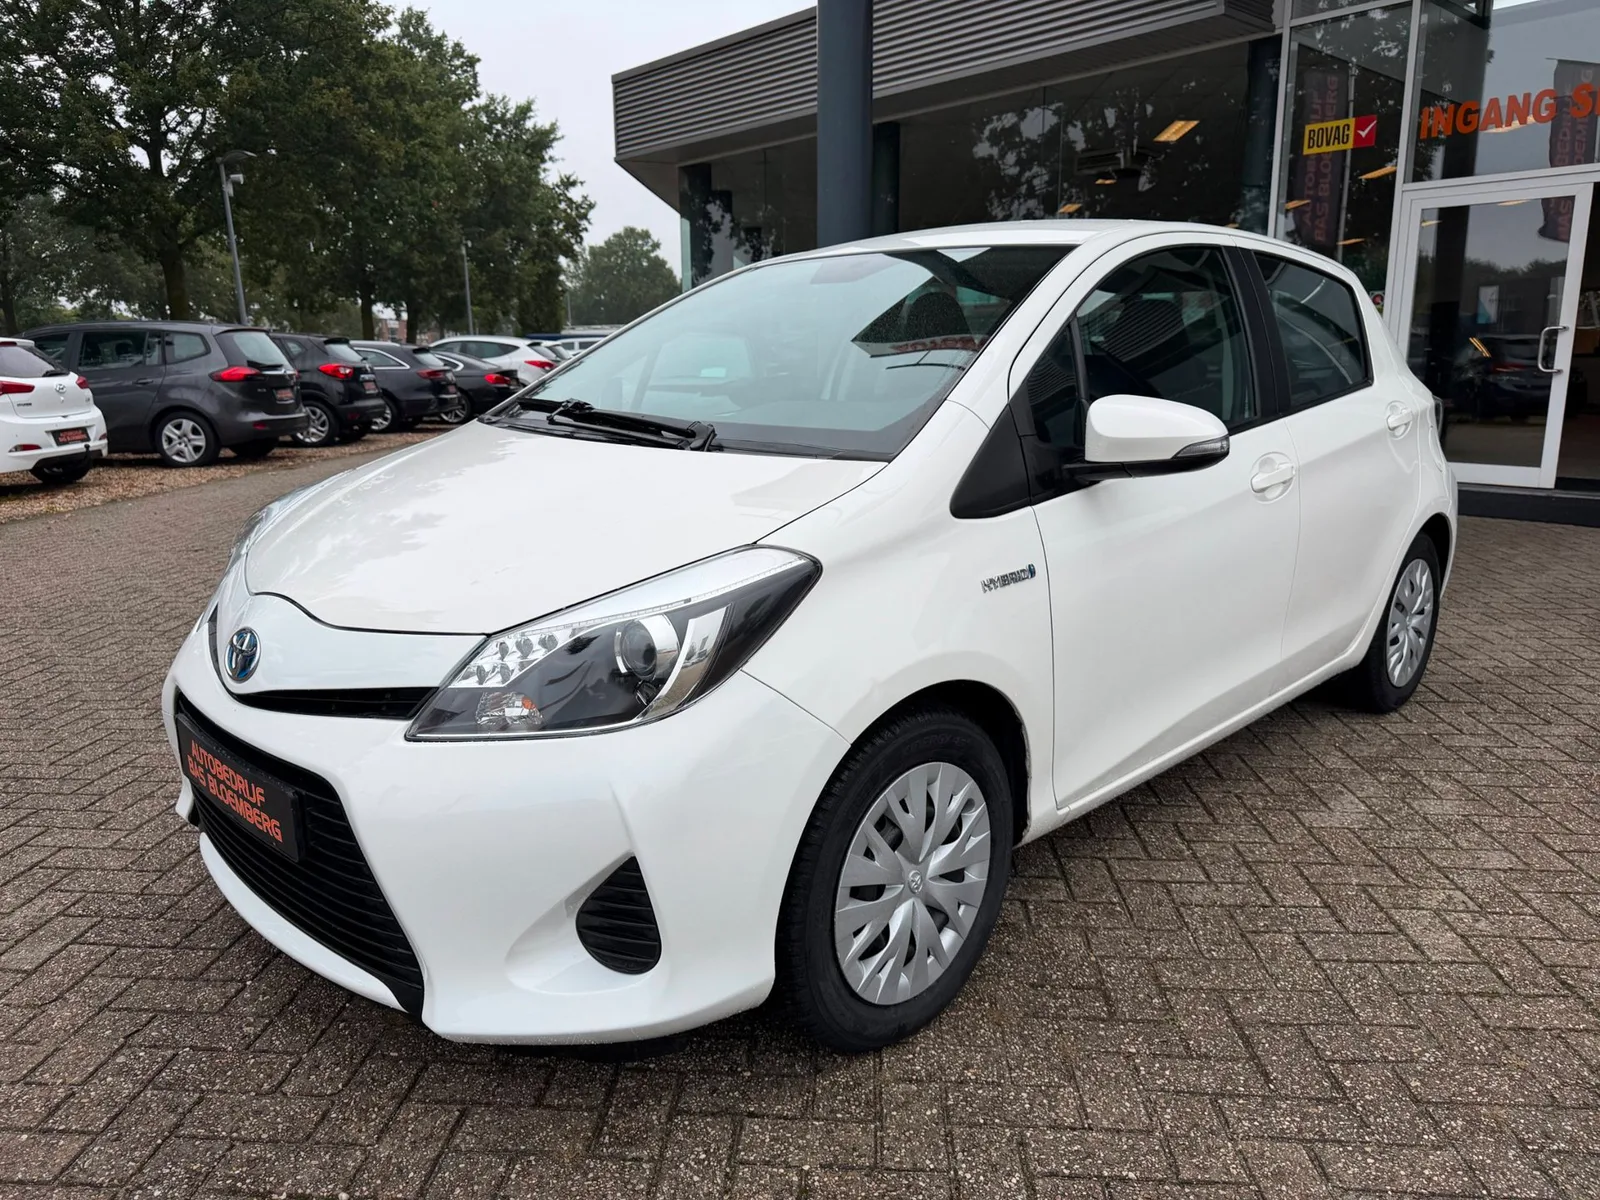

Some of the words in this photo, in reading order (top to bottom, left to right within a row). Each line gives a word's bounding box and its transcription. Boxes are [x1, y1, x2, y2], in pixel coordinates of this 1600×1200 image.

[1419, 88, 1558, 139] INGANG
[1569, 82, 1600, 118] S
[1307, 123, 1350, 149] BOVAG
[1314, 202, 1329, 241] BAS
[980, 567, 1029, 593] HYBRID
[191, 739, 265, 807] AUTOBEDRIJF
[187, 754, 207, 787] BAS
[207, 773, 283, 843] BLOEMBERG
